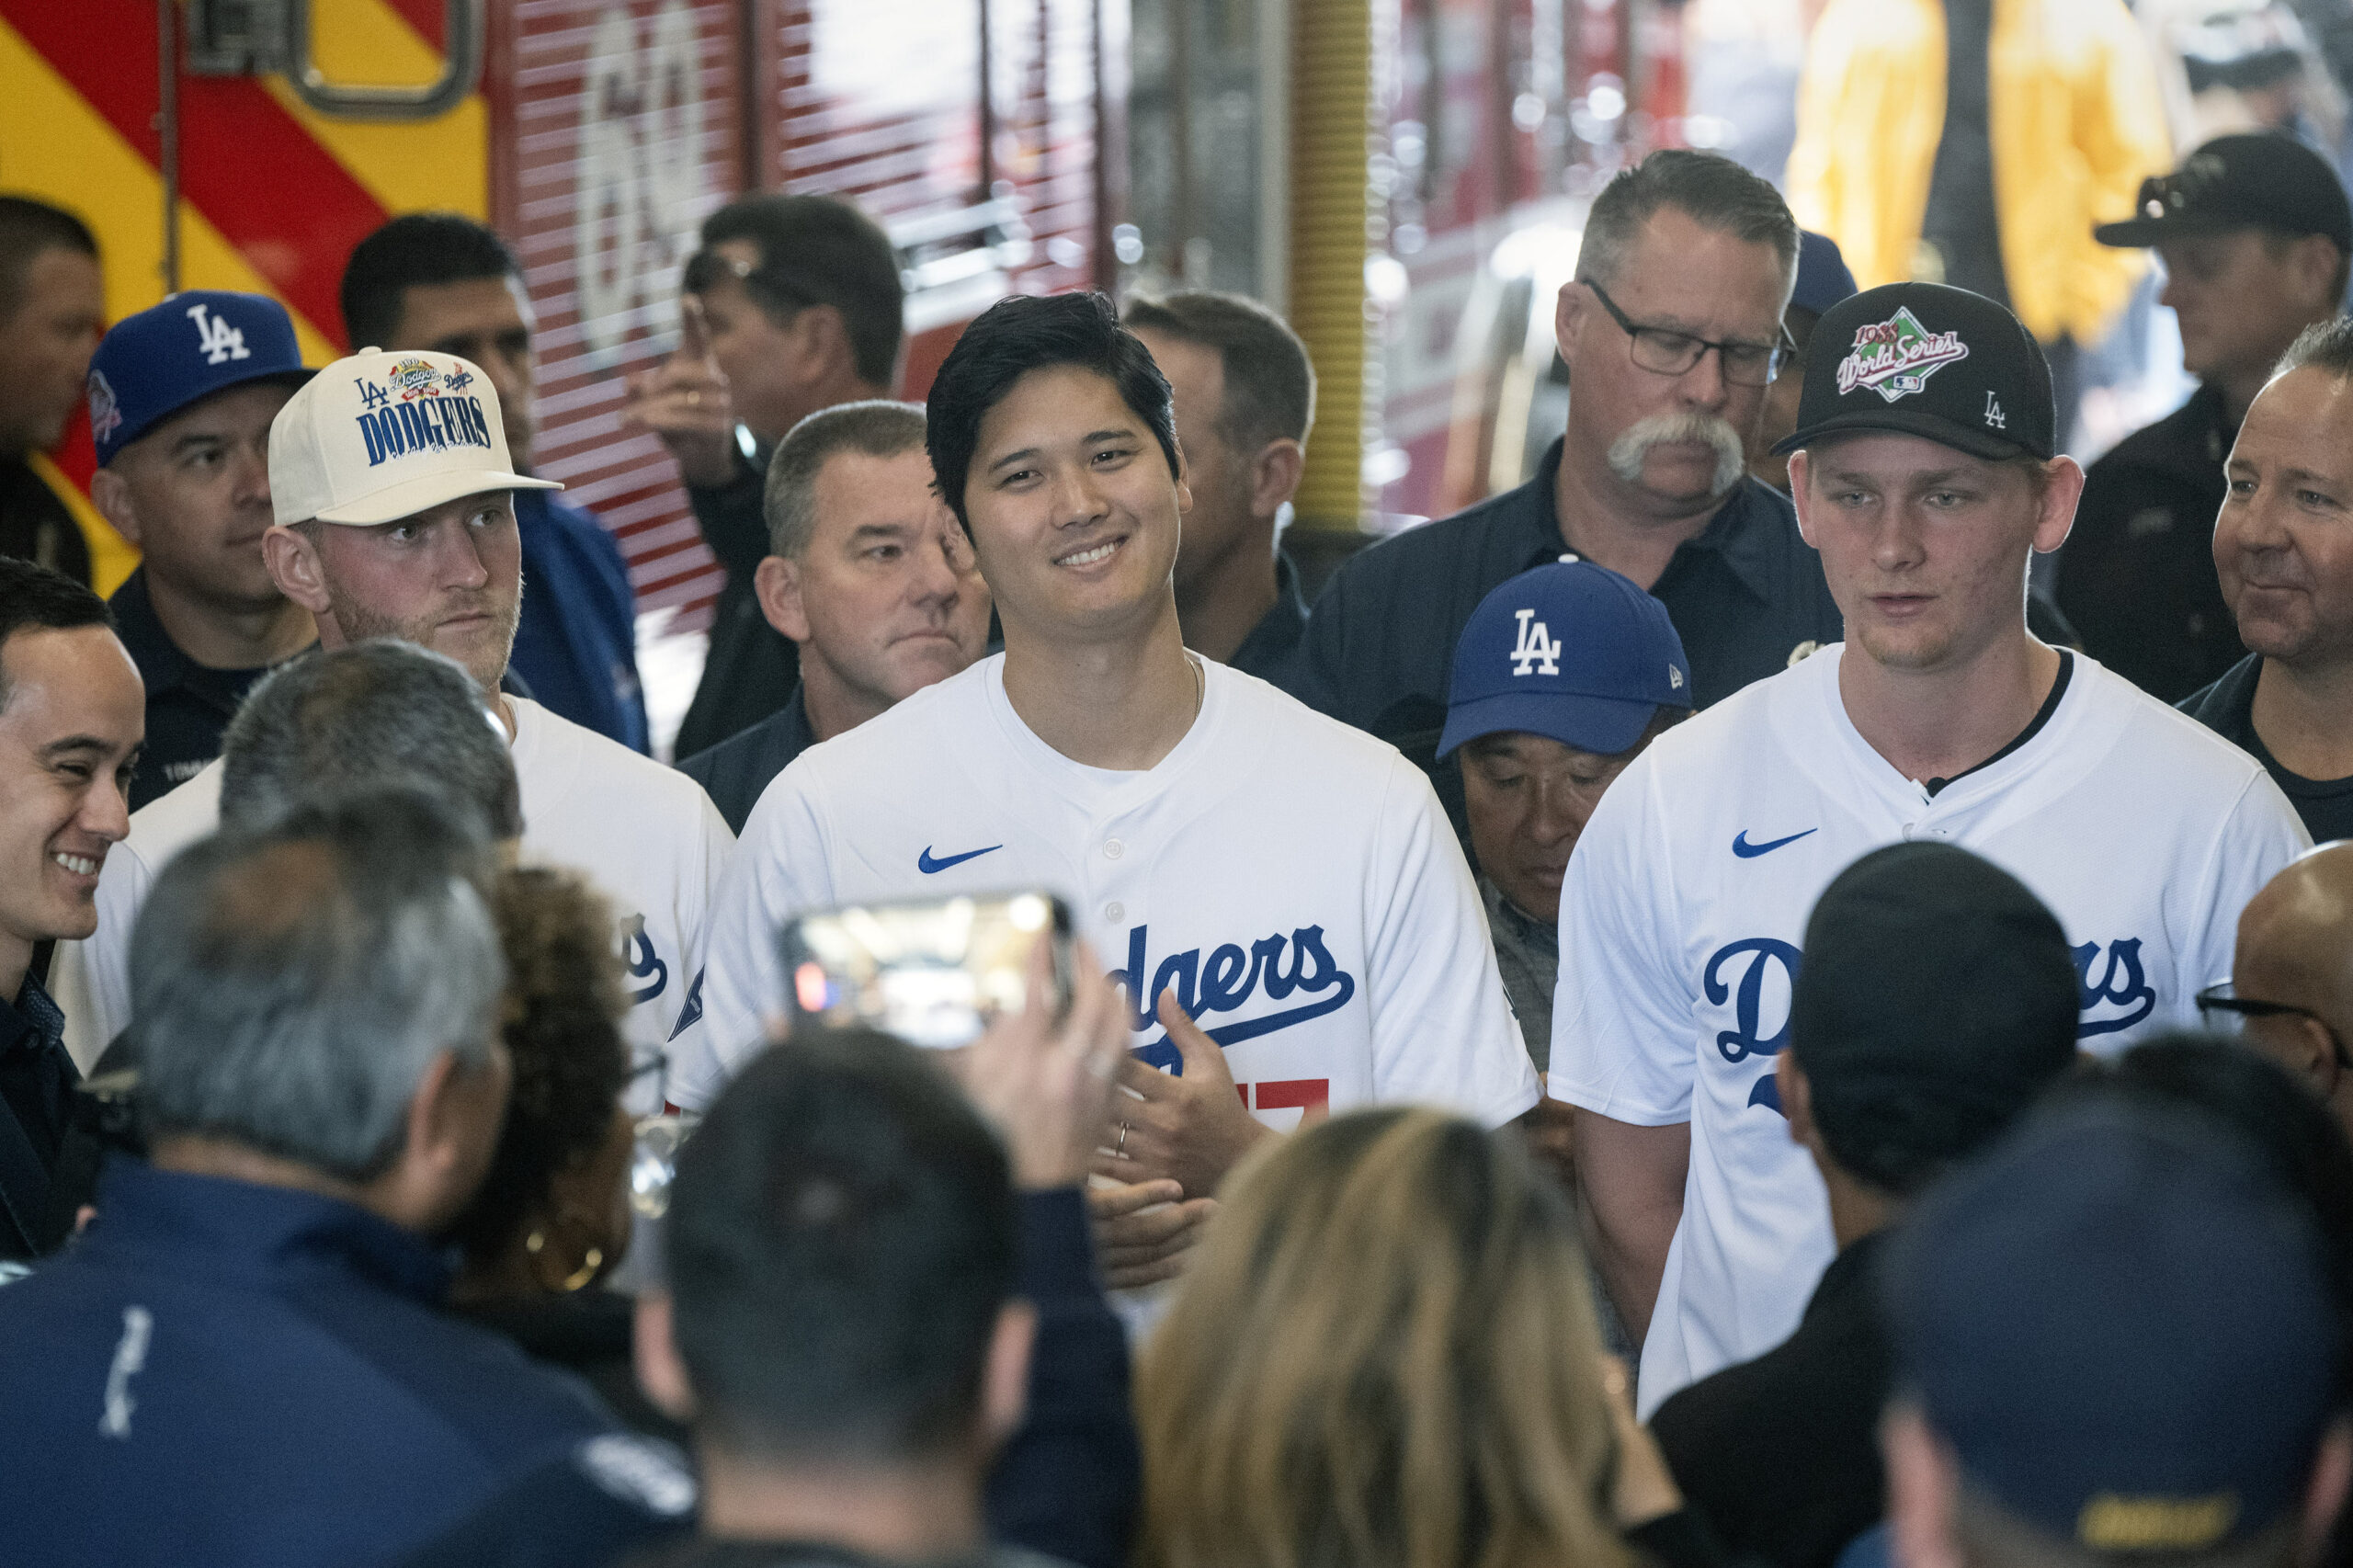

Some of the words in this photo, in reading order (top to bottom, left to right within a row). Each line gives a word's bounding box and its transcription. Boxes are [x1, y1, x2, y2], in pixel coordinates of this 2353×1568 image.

[187, 304, 250, 365] LA
[1837, 343, 1897, 393] World
[1893, 333, 1965, 369] Series
[1856, 324, 1899, 346] 1988
[354, 378, 390, 410] LA
[389, 367, 441, 392] Dodgers
[1984, 391, 2006, 428] LA
[356, 395, 491, 467] DODGERS
[1510, 608, 1562, 676] LA
[1099, 924, 1355, 1077] dgers
